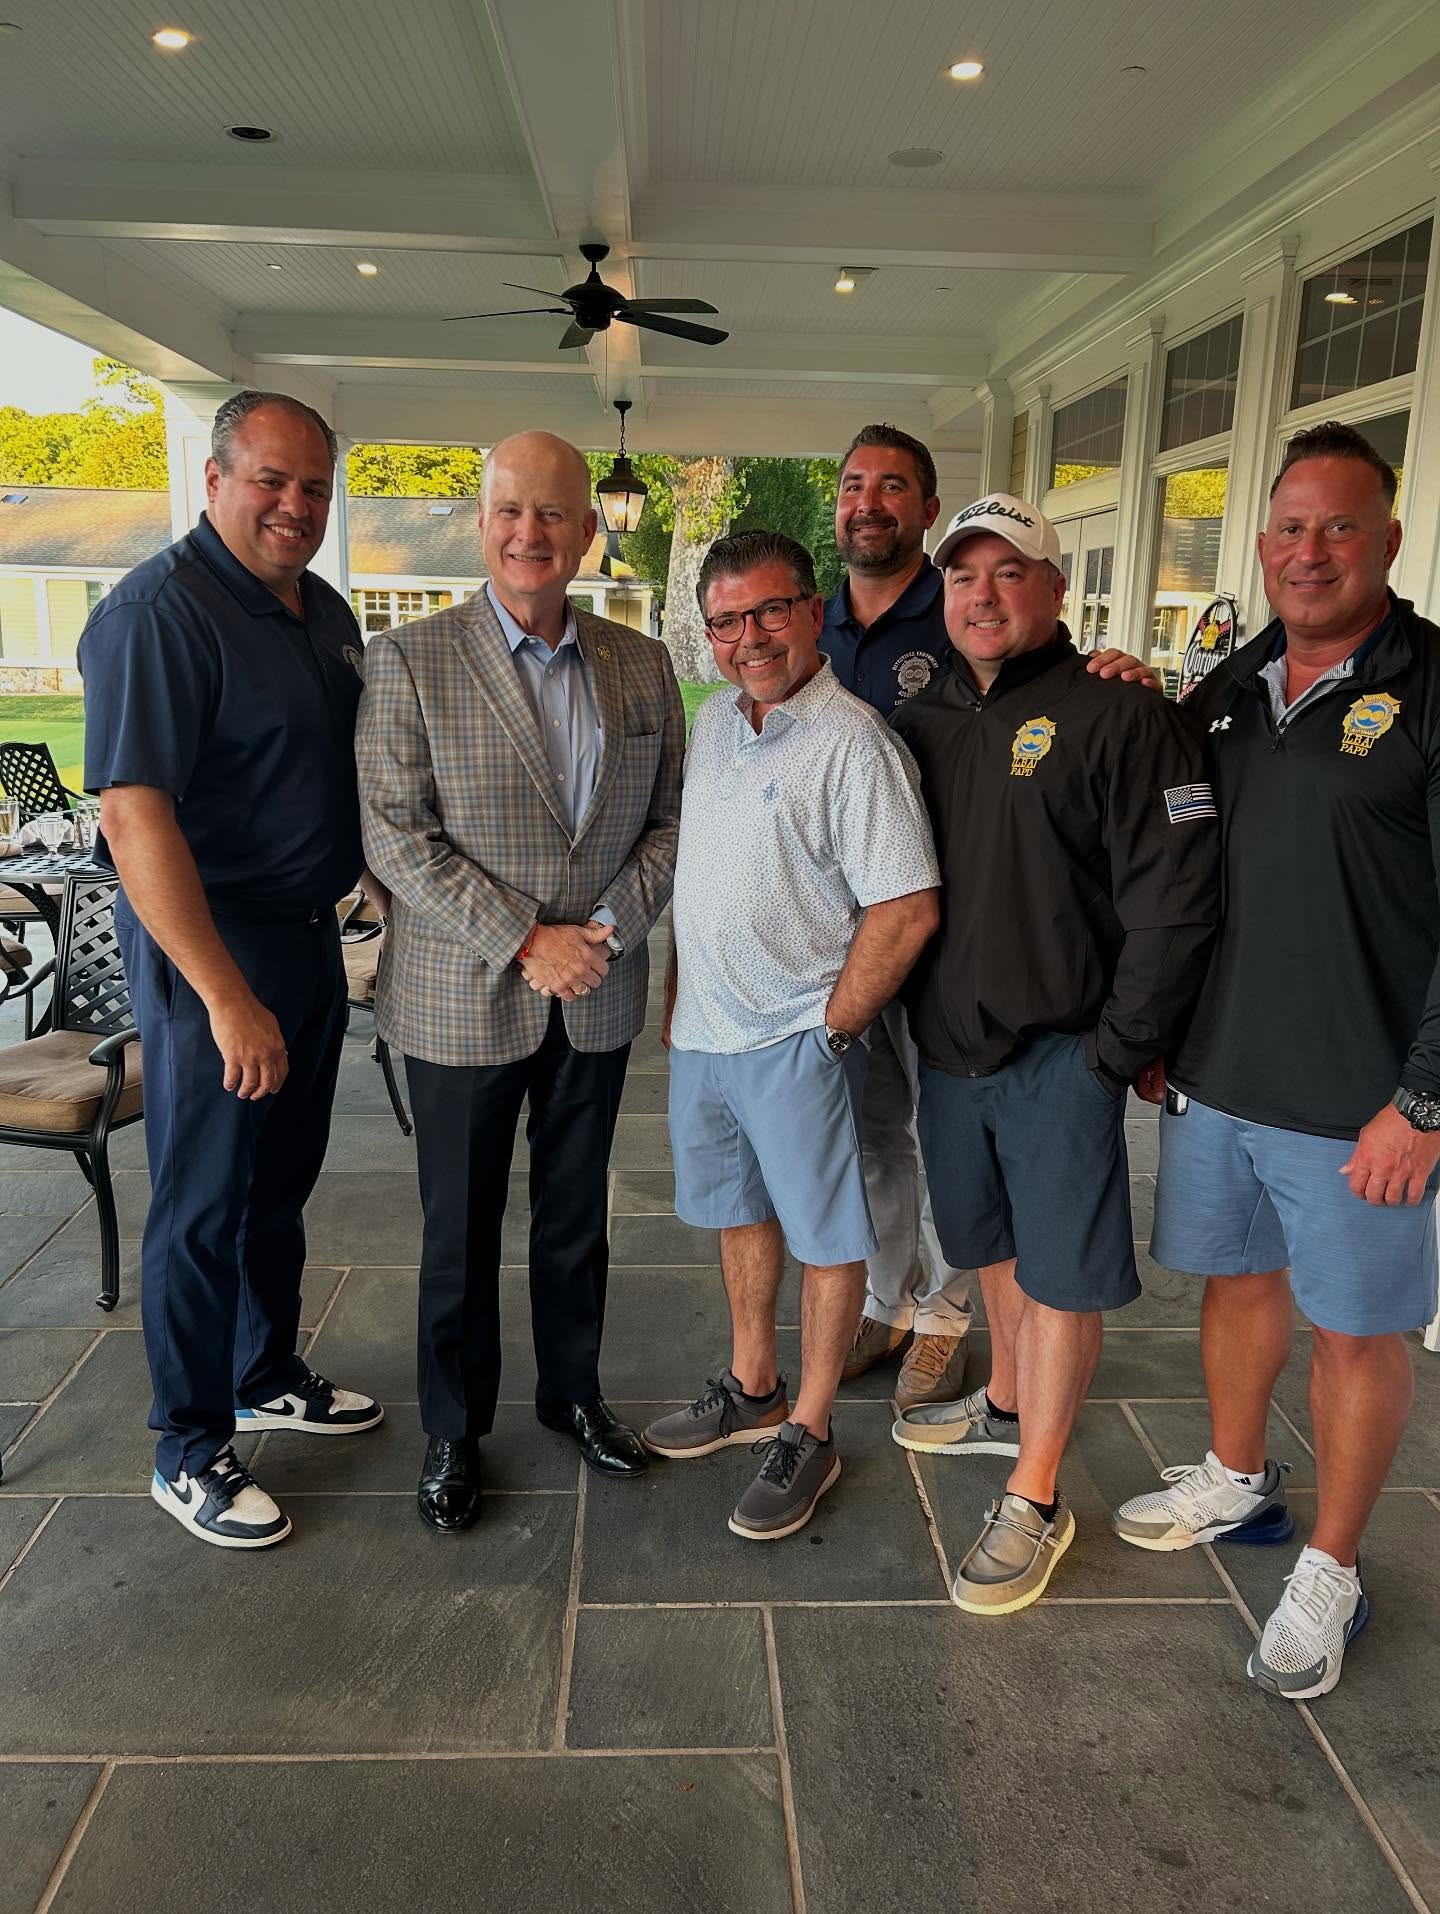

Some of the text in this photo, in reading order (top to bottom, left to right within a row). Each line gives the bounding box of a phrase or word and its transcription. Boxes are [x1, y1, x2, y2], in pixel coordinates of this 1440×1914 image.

[955, 500, 1035, 528] Titleist
[1339, 744, 1369, 757] PAPD
[1010, 767, 1033, 777] PAPD
